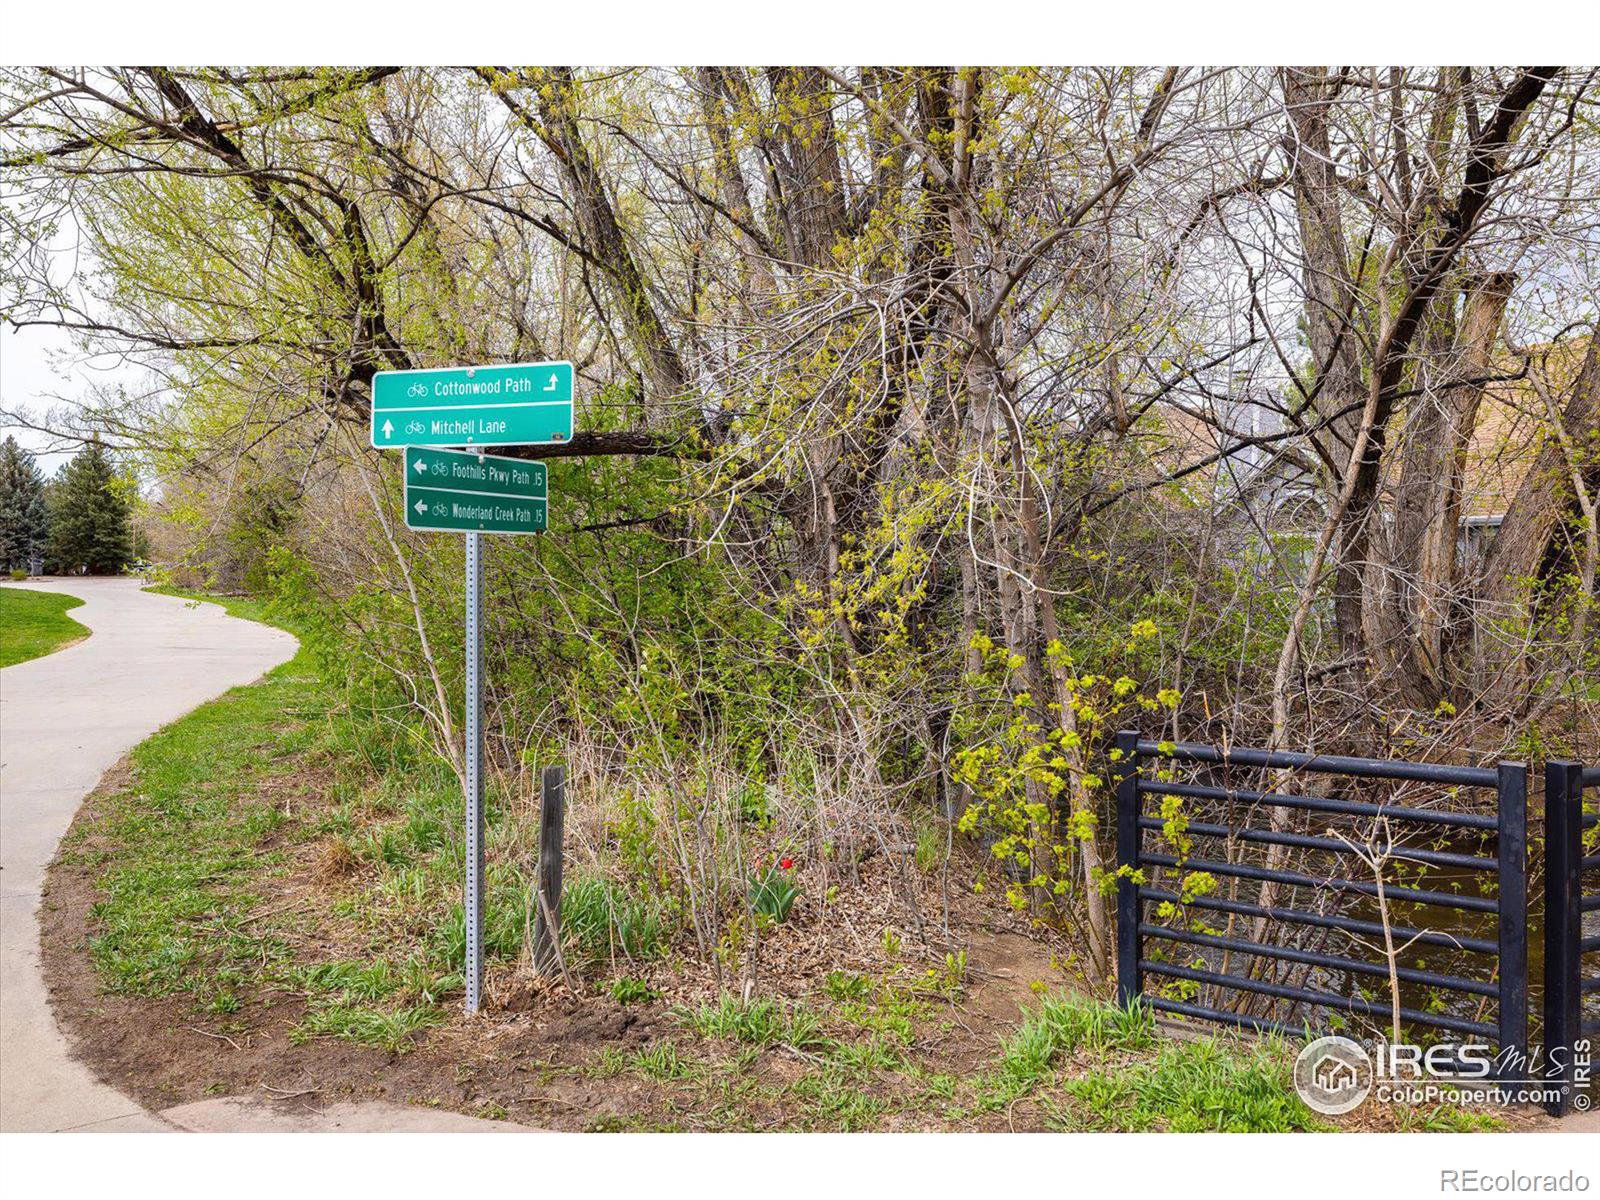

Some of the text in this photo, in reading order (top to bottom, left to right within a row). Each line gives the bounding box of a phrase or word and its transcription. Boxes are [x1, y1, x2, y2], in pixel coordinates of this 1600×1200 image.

[434, 378, 531, 396] Cottonwood Path
[431, 419, 506, 435] Mitchell Lane
[452, 463, 486, 480] Foothills
[489, 467, 509, 485] Pkwy
[512, 469, 529, 485] Path
[452, 503, 492, 520] Wonderland
[495, 506, 514, 521] Creek
[516, 508, 531, 522] Path
